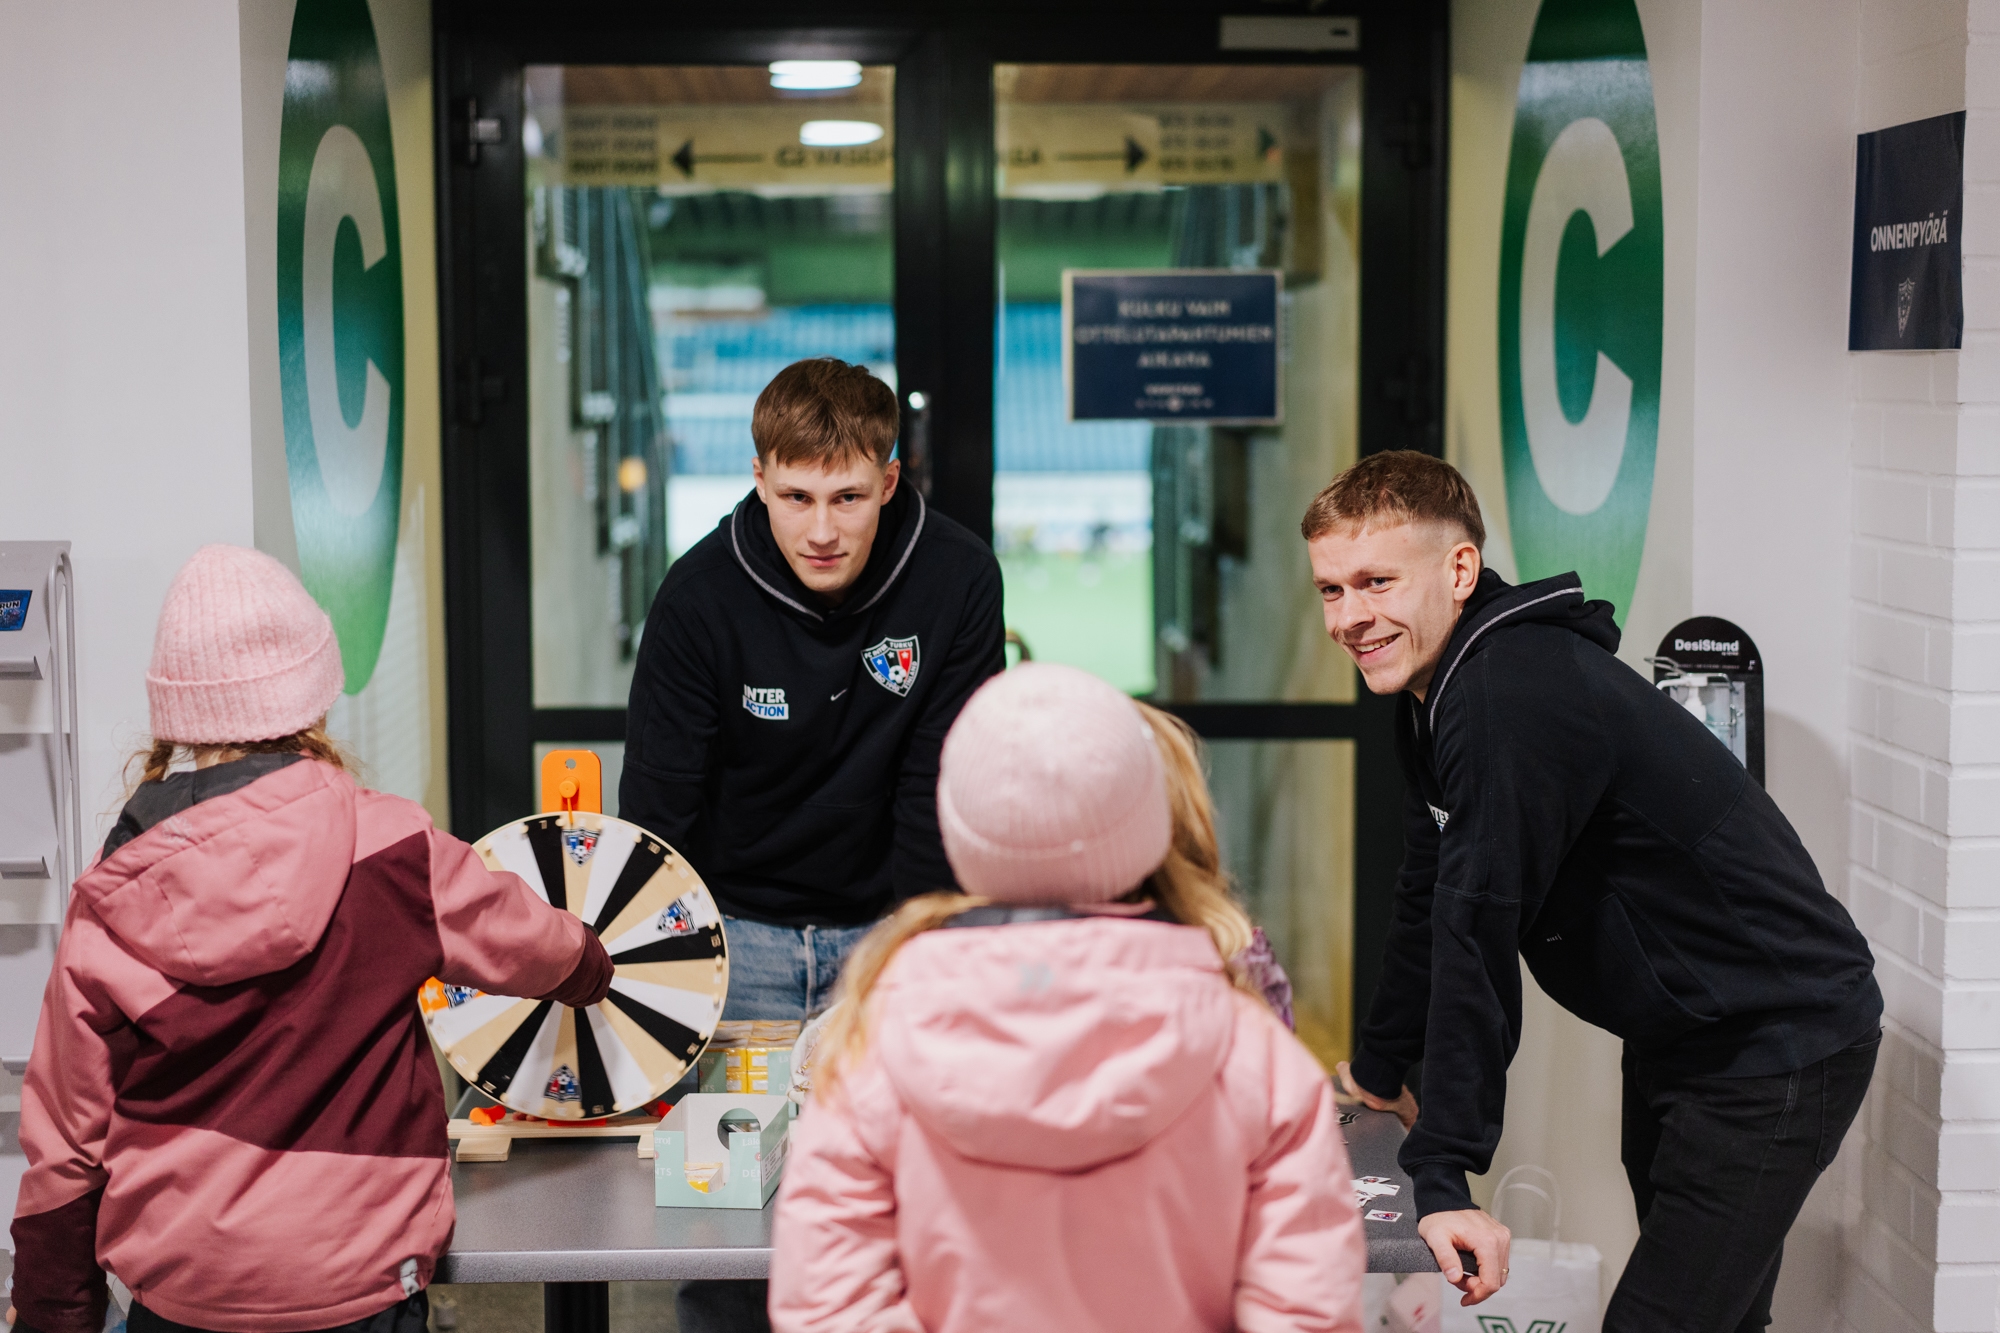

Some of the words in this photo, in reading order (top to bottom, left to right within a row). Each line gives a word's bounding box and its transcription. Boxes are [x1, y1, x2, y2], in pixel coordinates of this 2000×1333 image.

[1870, 209, 1948, 252] ONNENPYÖRÄ
[303, 124, 391, 517] C
[1520, 117, 1634, 515] C
[890, 641, 913, 649] TURKU
[1674, 638, 1739, 652] DesiStand
[743, 683, 786, 704] INTER
[745, 699, 785, 717] ACTION
